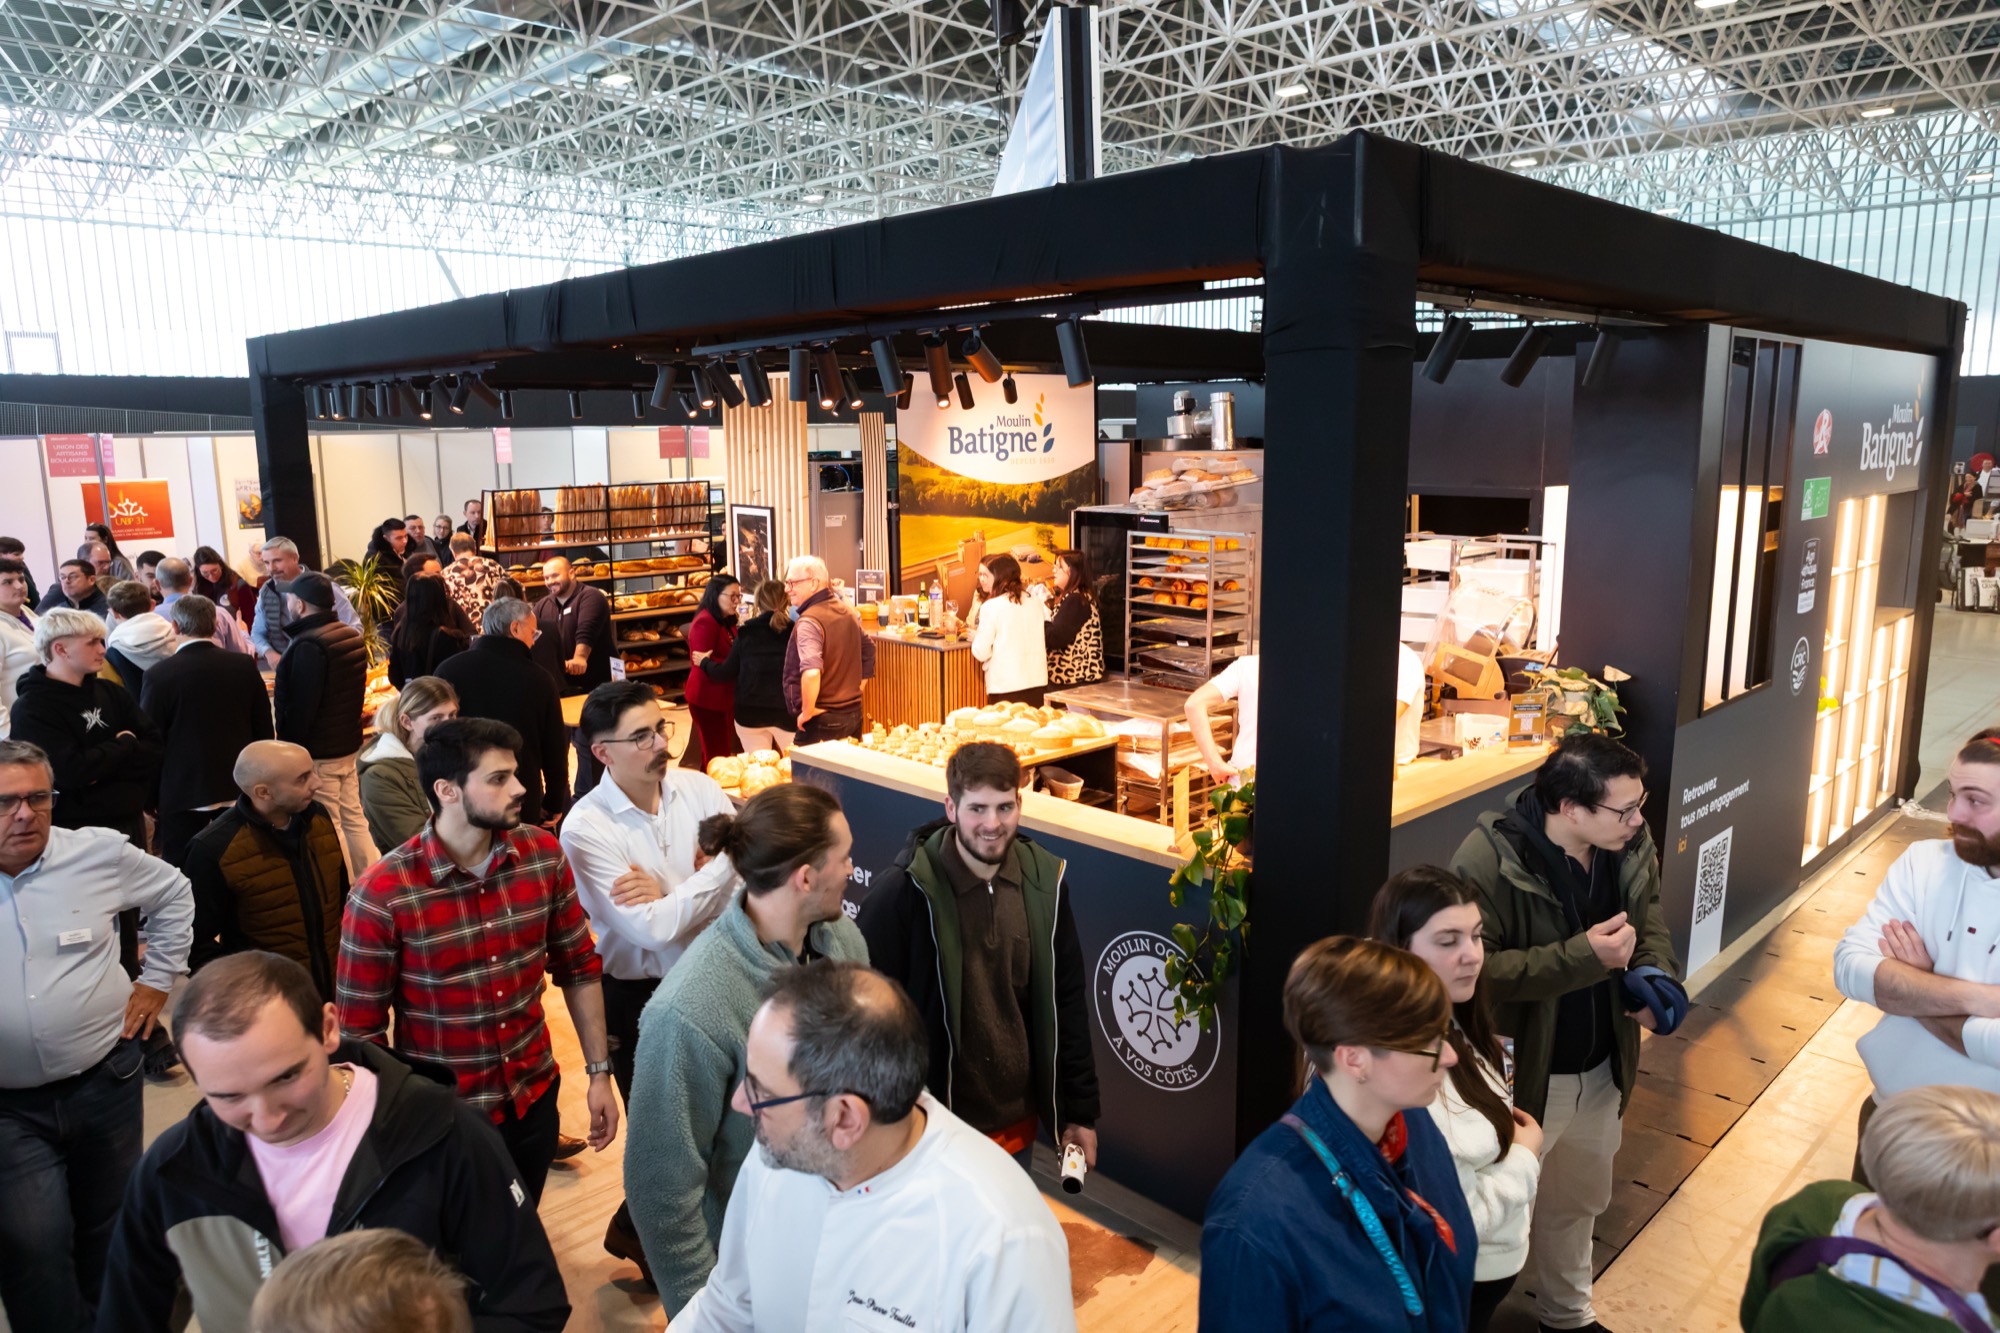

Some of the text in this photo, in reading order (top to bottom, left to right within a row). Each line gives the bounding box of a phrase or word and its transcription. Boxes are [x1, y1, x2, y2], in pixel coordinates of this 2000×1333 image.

[996, 414, 1031, 427] Moulin
[1892, 402, 1913, 423] Moulin
[947, 423, 1037, 461] Batigne
[1860, 418, 1914, 481] Batigne
[1681, 779, 1750, 829] tous nos engagement
[1683, 777, 1717, 805] Retrouvez
[1103, 938, 1150, 976] MOULIN
[1126, 1048, 1151, 1077] VOS
[1155, 1064, 1198, 1084] CÔTÉS
